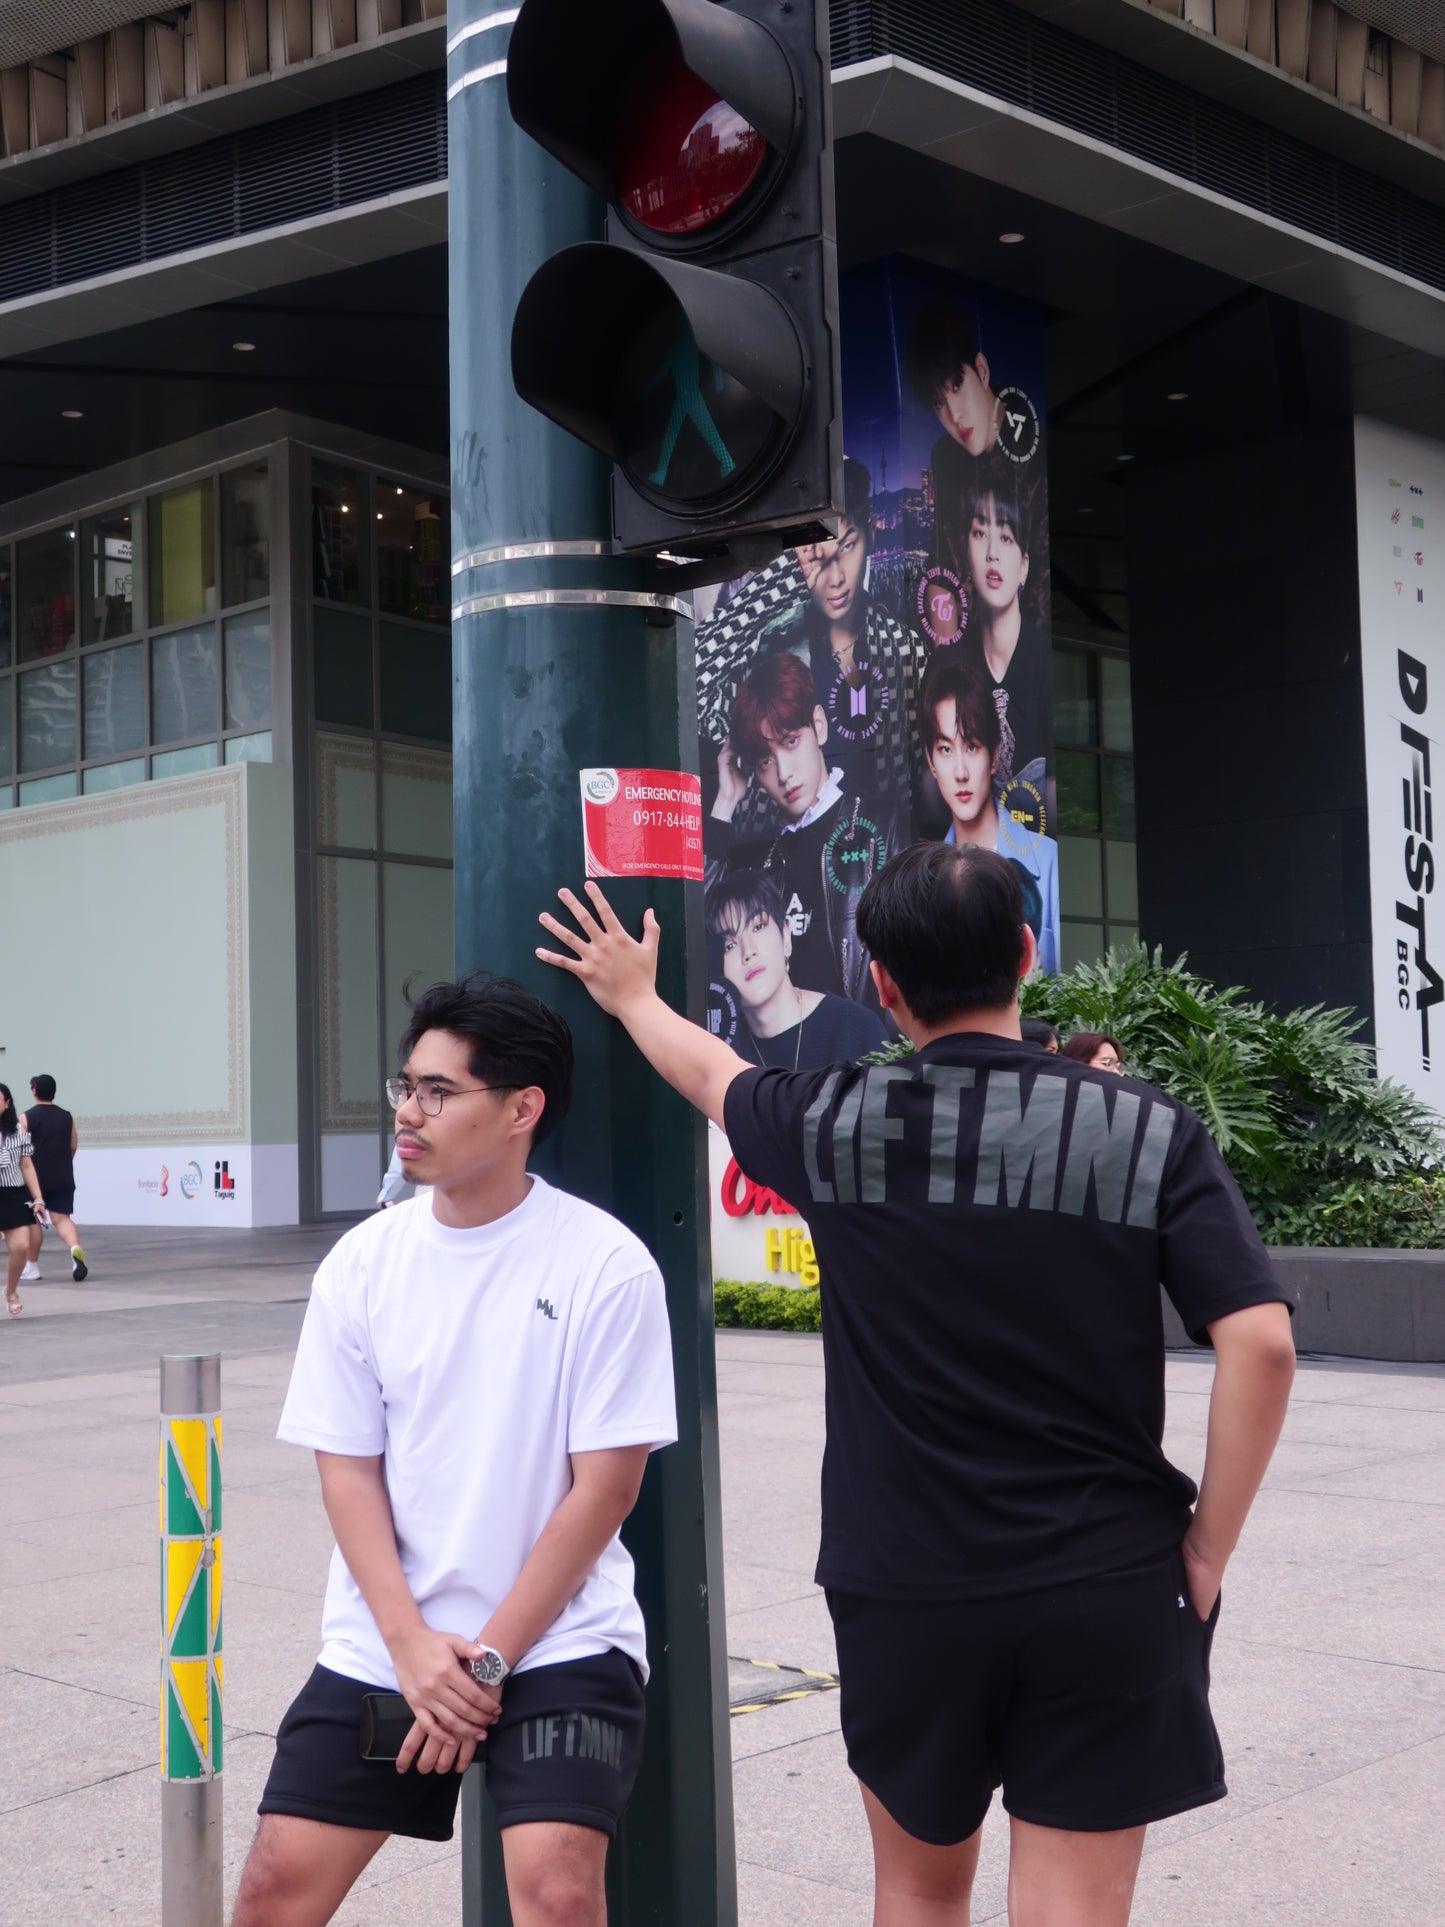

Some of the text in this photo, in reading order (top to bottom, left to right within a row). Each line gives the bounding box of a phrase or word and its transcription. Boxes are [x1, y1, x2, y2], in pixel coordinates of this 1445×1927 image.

[880, 686, 889, 709] SUGA
[590, 780, 610, 790] BGC
[625, 786, 702, 807] EMERGENCY HOTLINE
[633, 810, 700, 831] 0917-844-HELP
[1397, 938, 1410, 1011] BGC
[183, 1174, 199, 1186] BGC
[214, 1190, 235, 1201] Taguig
